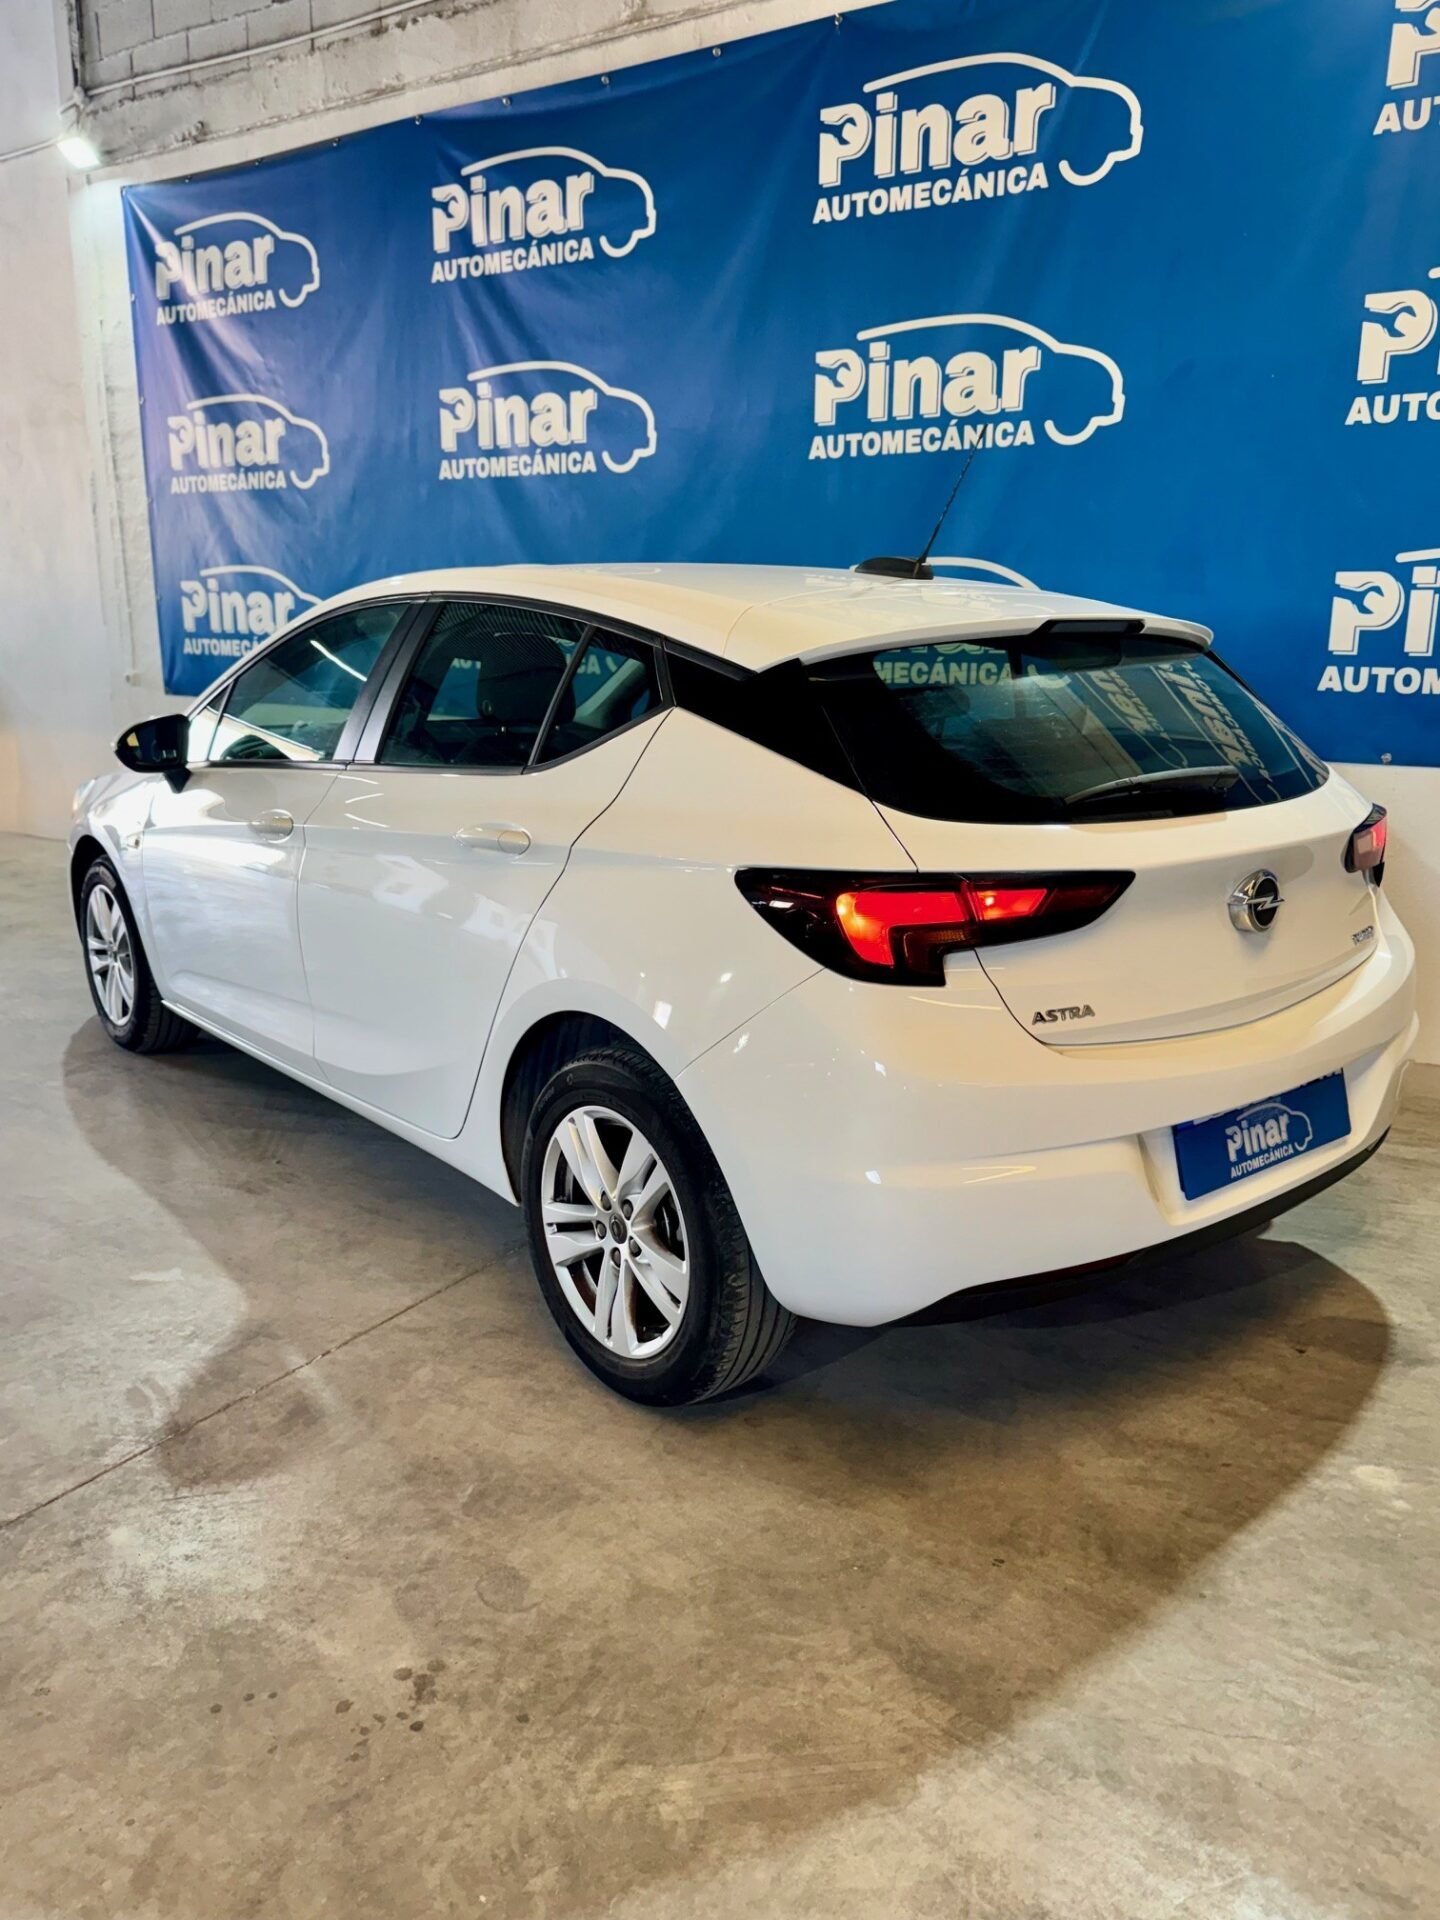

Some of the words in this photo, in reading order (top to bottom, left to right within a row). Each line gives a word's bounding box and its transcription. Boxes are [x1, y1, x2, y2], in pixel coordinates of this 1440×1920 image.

[818, 82, 1056, 188] Pinar
[1372, 95, 1440, 135] AU
[432, 171, 594, 254] Pinar
[812, 162, 1049, 224] AUTOMECÁNICA
[155, 234, 275, 300] Pinar
[431, 240, 594, 283] AUTOMECÁNICA
[156, 290, 276, 326] AUTOMECÁNICA
[1357, 289, 1440, 385] P
[814, 341, 1041, 426] Pinar
[167, 410, 286, 471] Pinar
[439, 382, 597, 452] Pinar
[808, 419, 1035, 460] AUTOMECÁNICA
[171, 467, 287, 495] AUTOMECÁNICA
[438, 449, 597, 480] AUTOMECÁNICA
[180, 578, 296, 636] Pinar
[1032, 1004, 1096, 1025] ASTRA
[1225, 1113, 1290, 1162] Pinar
[1231, 1144, 1294, 1179] AUTOMECÁNICA
